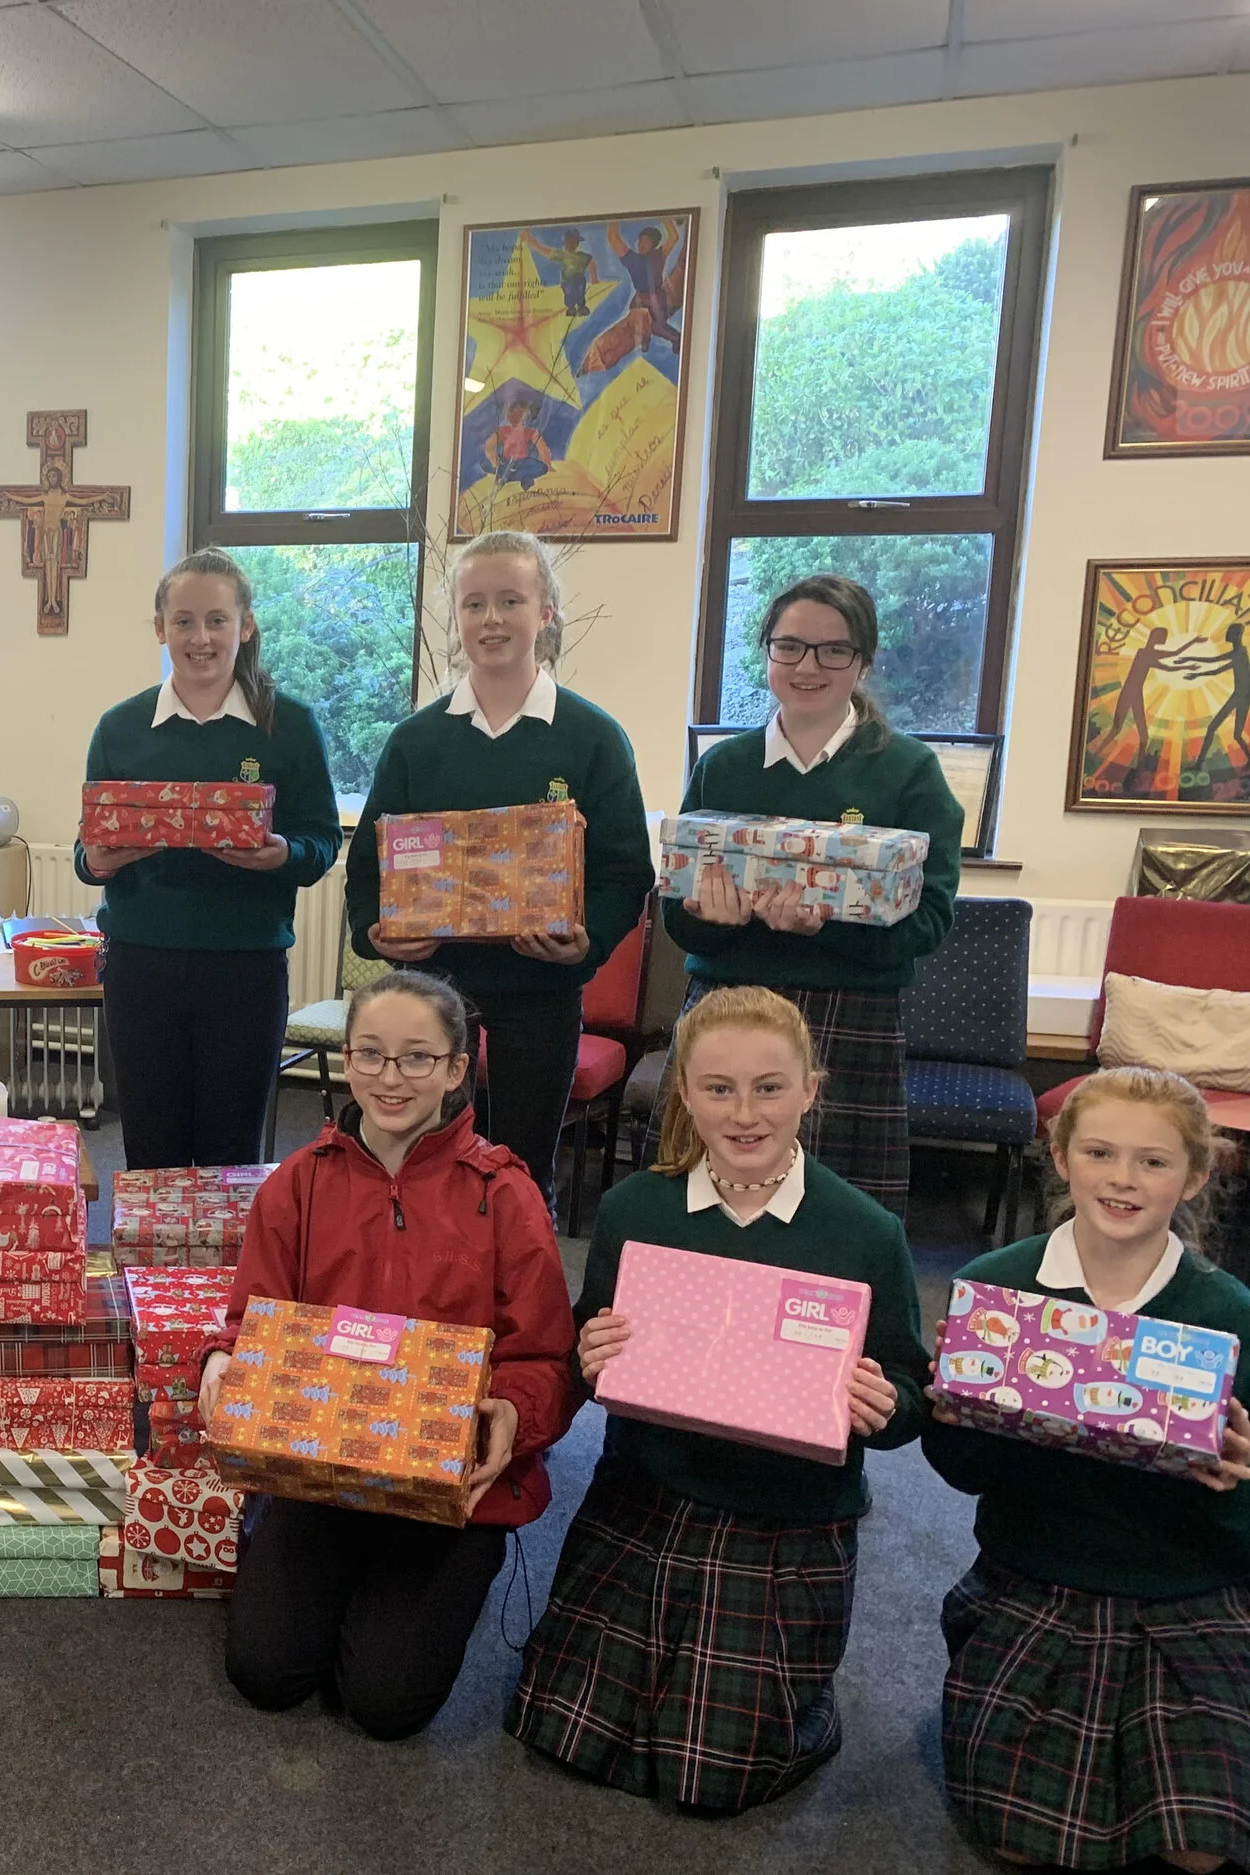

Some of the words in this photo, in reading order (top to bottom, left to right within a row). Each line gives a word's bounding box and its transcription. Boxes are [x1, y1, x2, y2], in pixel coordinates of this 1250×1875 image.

[1157, 291, 1183, 321] WILL
[1178, 266, 1212, 294] GIVE
[1213, 260, 1244, 280] YOU
[41, 1282, 50, 1307] JOYOUS
[785, 1298, 830, 1321] GIRL
[336, 1319, 376, 1340] GIRL
[1141, 1336, 1194, 1362] BOY
